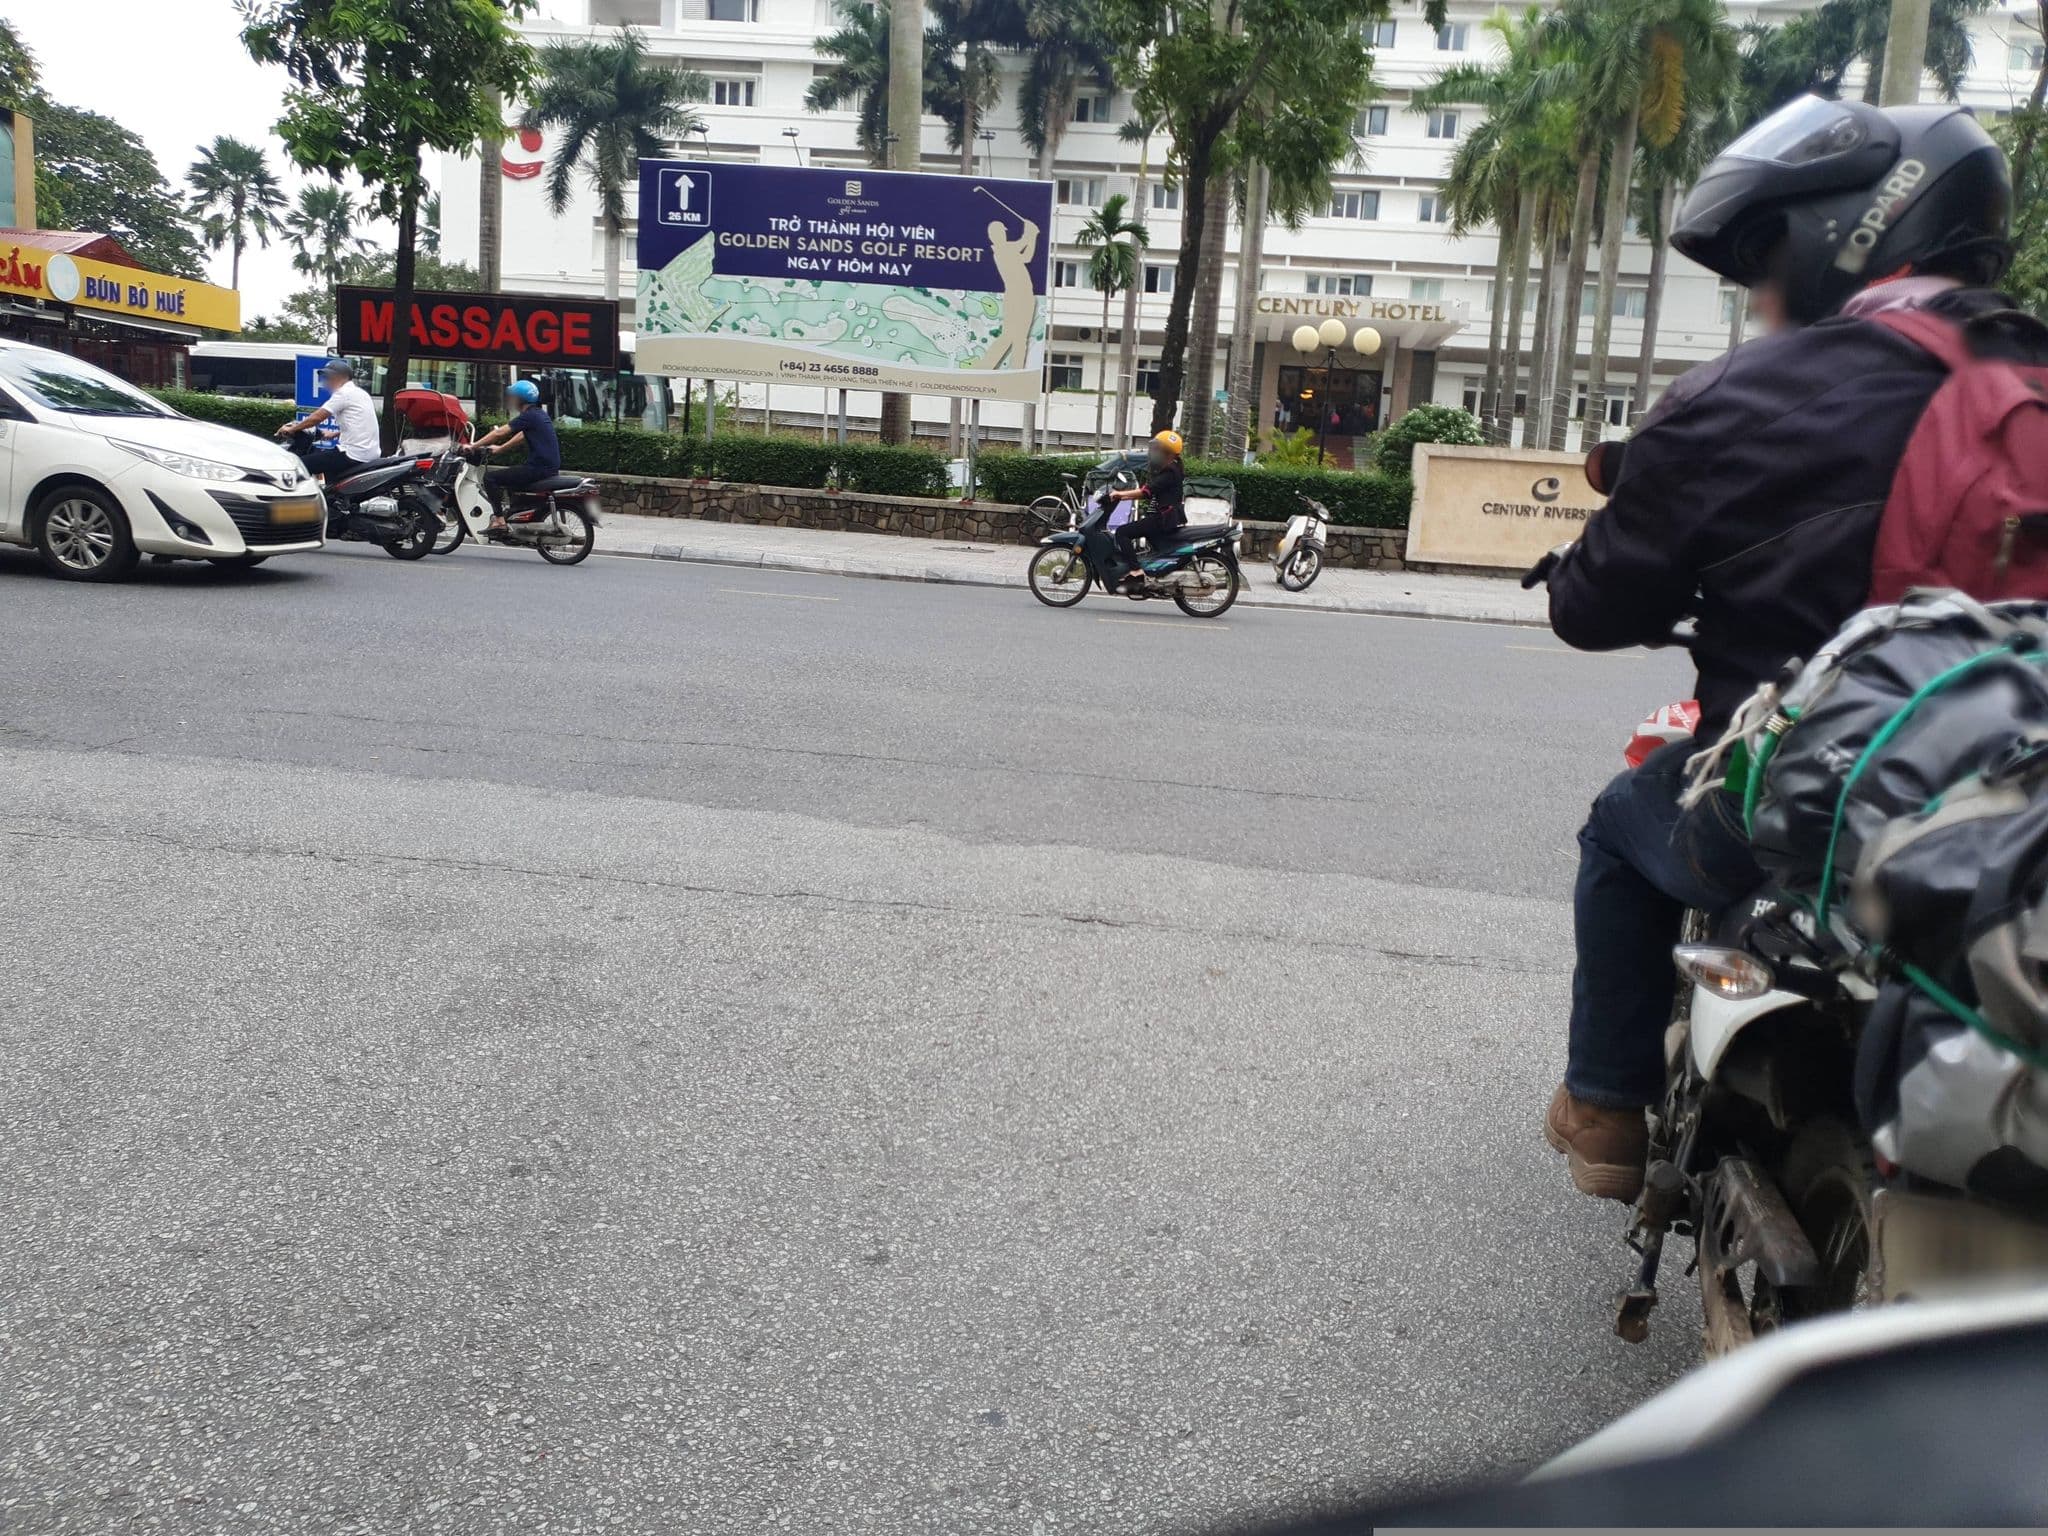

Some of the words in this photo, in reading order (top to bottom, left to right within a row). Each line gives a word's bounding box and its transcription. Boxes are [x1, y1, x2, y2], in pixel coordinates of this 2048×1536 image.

[827, 197, 856, 205] GOLDEN
[668, 211, 682, 221] 26
[683, 212, 701, 222] KM
[769, 215, 801, 232] TRỞ
[808, 219, 860, 236] THÀNH
[866, 222, 894, 240] HỘI
[901, 224, 935, 240] VIÊN
[1834, 159, 1926, 273] OPARD
[719, 232, 789, 249] GOLDEN
[797, 237, 853, 254] SANDS
[861, 241, 907, 257] GOLF
[914, 244, 984, 262] RESORT
[787, 256, 832, 271] NGAY
[838, 257, 873, 274] HÔM
[879, 262, 912, 276] NAY
[86, 274, 121, 304] BÚN
[156, 288, 186, 316] HUẾ
[1257, 297, 1359, 317] CENTURY
[1371, 302, 1446, 322] HOTEL
[360, 300, 592, 355] MASSAGE
[779, 360, 807, 373] (+84)
[809, 363, 821, 372] 23
[824, 364, 850, 374] 4656
[852, 366, 879, 377] 8888
[1482, 502, 1541, 518] CENTURY
